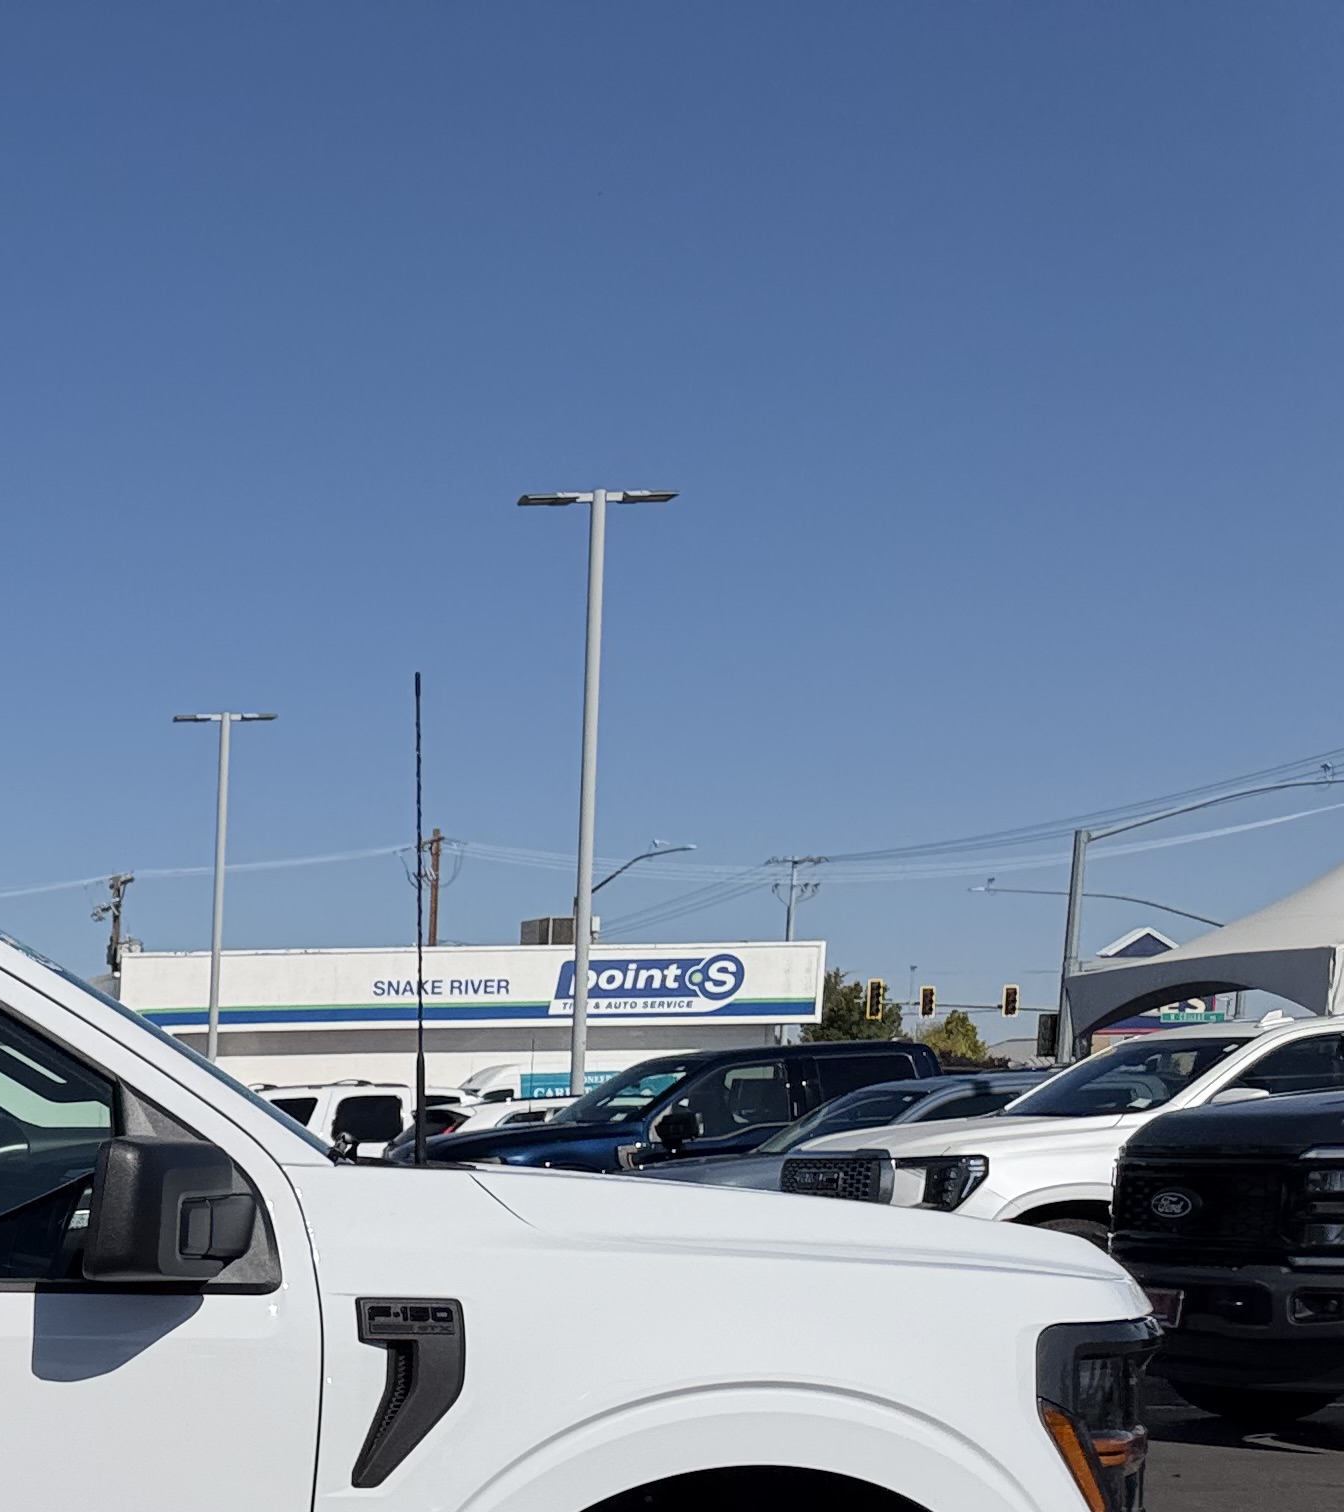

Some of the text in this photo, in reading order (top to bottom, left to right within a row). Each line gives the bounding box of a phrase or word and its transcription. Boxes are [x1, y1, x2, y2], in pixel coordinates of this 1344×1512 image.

[704, 960, 737, 994] S
[373, 979, 510, 997] SNAKE RIVER
[593, 1001, 600, 1010] &
[605, 1001, 638, 1010] AUTO
[642, 1000, 694, 1009] SERVICE
[367, 1305, 453, 1322] F-150
